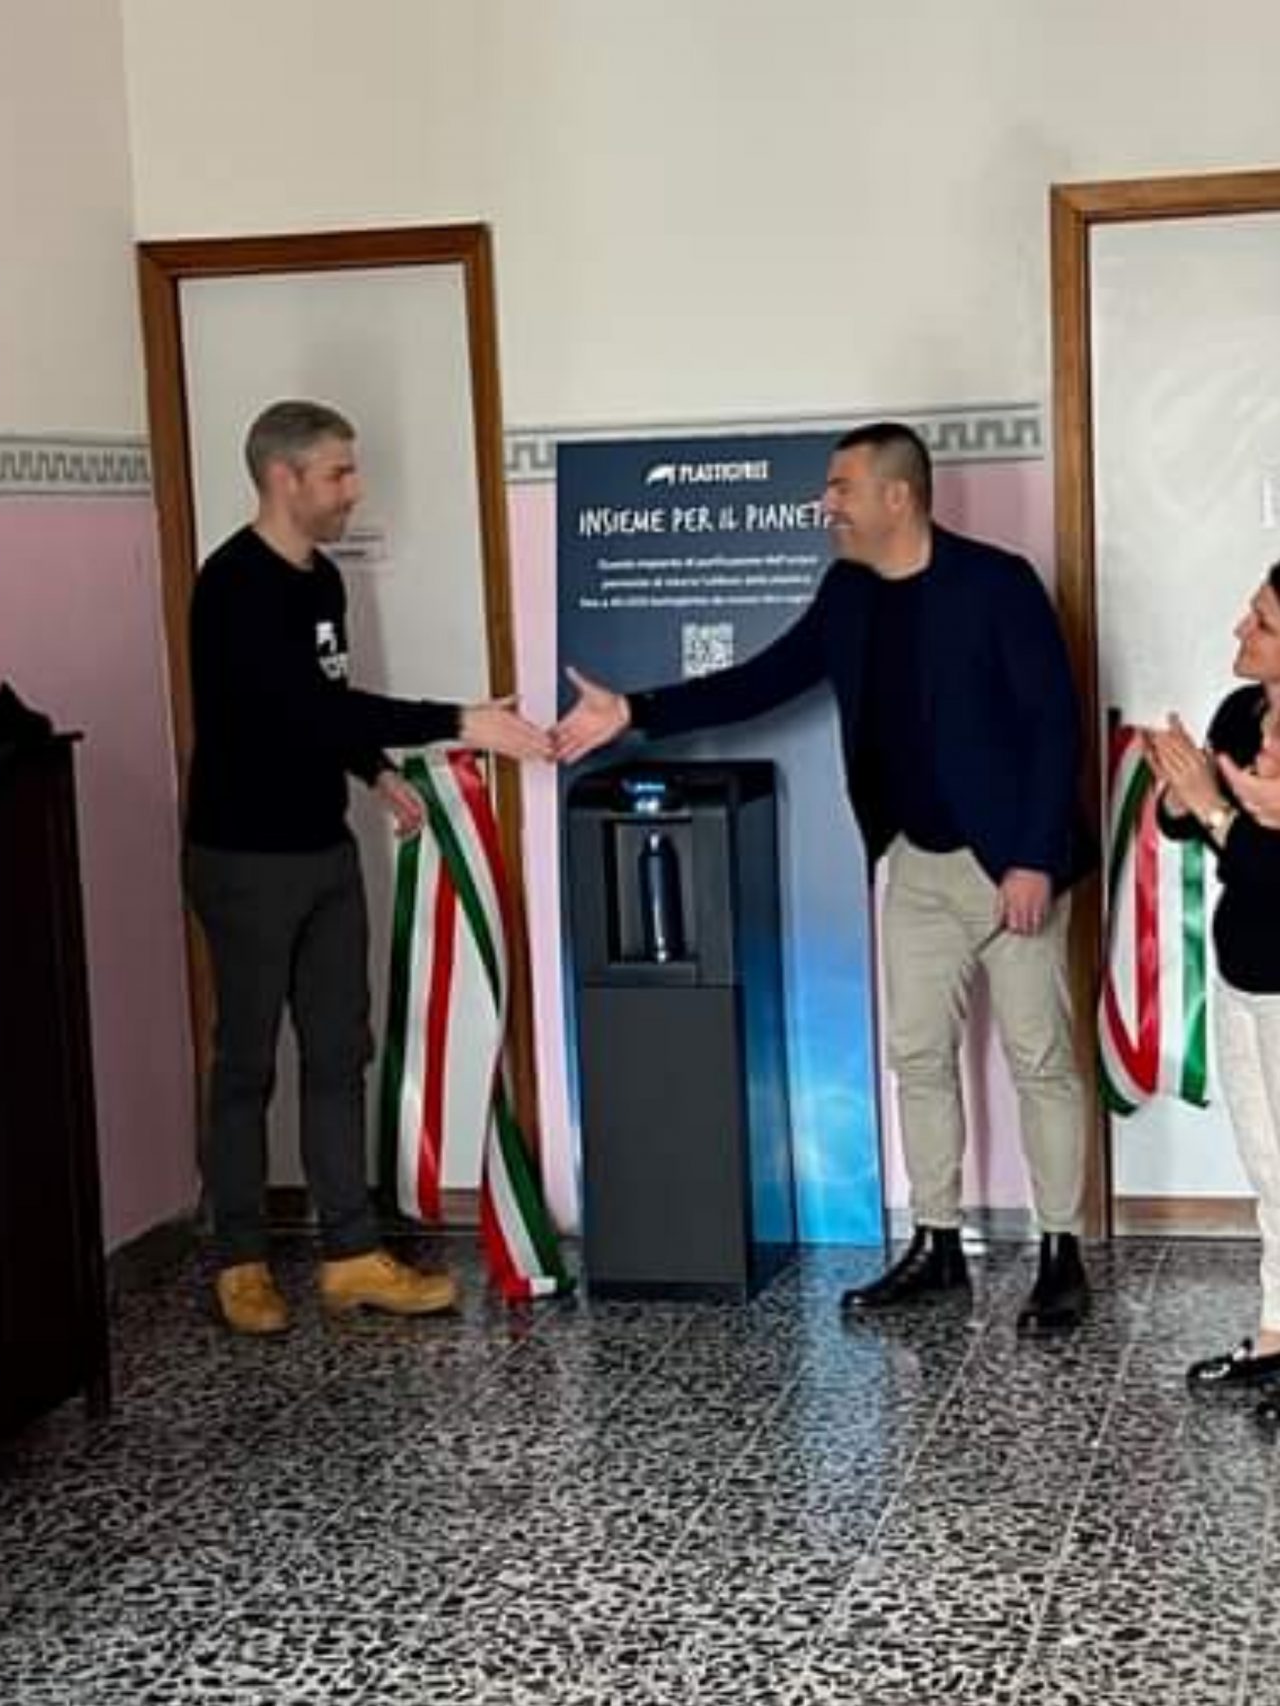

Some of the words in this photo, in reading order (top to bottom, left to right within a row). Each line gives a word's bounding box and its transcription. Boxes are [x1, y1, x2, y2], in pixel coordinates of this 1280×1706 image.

[579, 506, 665, 538] INSIEME
[672, 504, 713, 533] PER
[719, 504, 738, 530] IL
